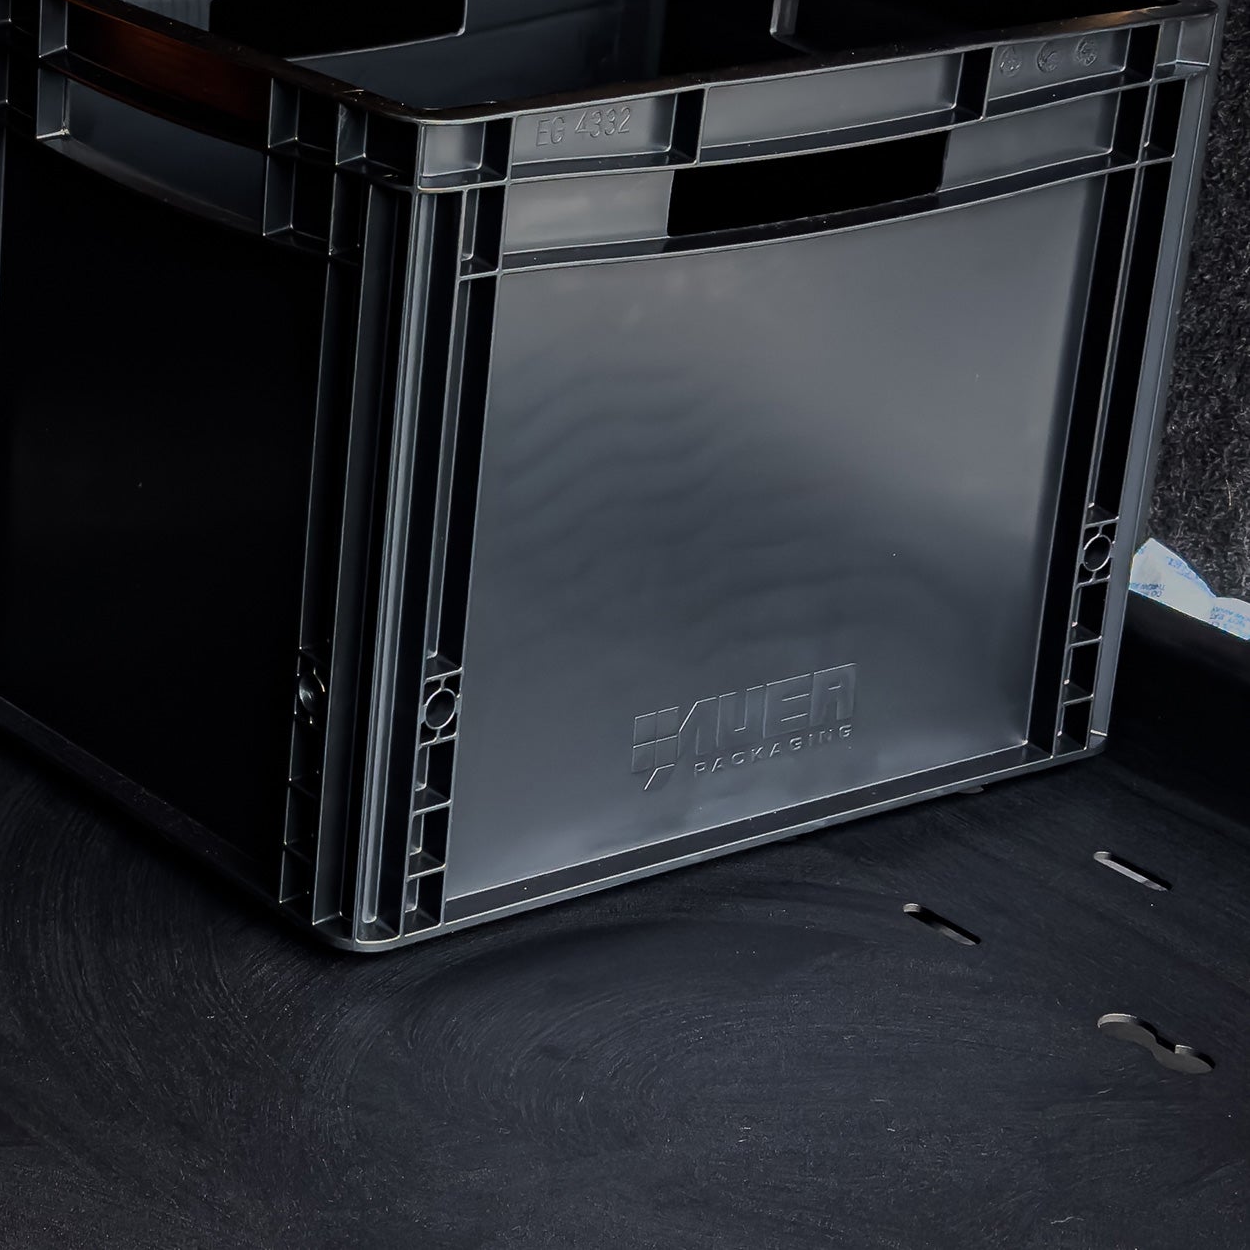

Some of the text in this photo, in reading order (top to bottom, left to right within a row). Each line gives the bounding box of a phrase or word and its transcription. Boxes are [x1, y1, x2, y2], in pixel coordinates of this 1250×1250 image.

[535, 107, 631, 147] EG 4332
[677, 662, 857, 758] AUER
[693, 724, 853, 776] PACKAGING
